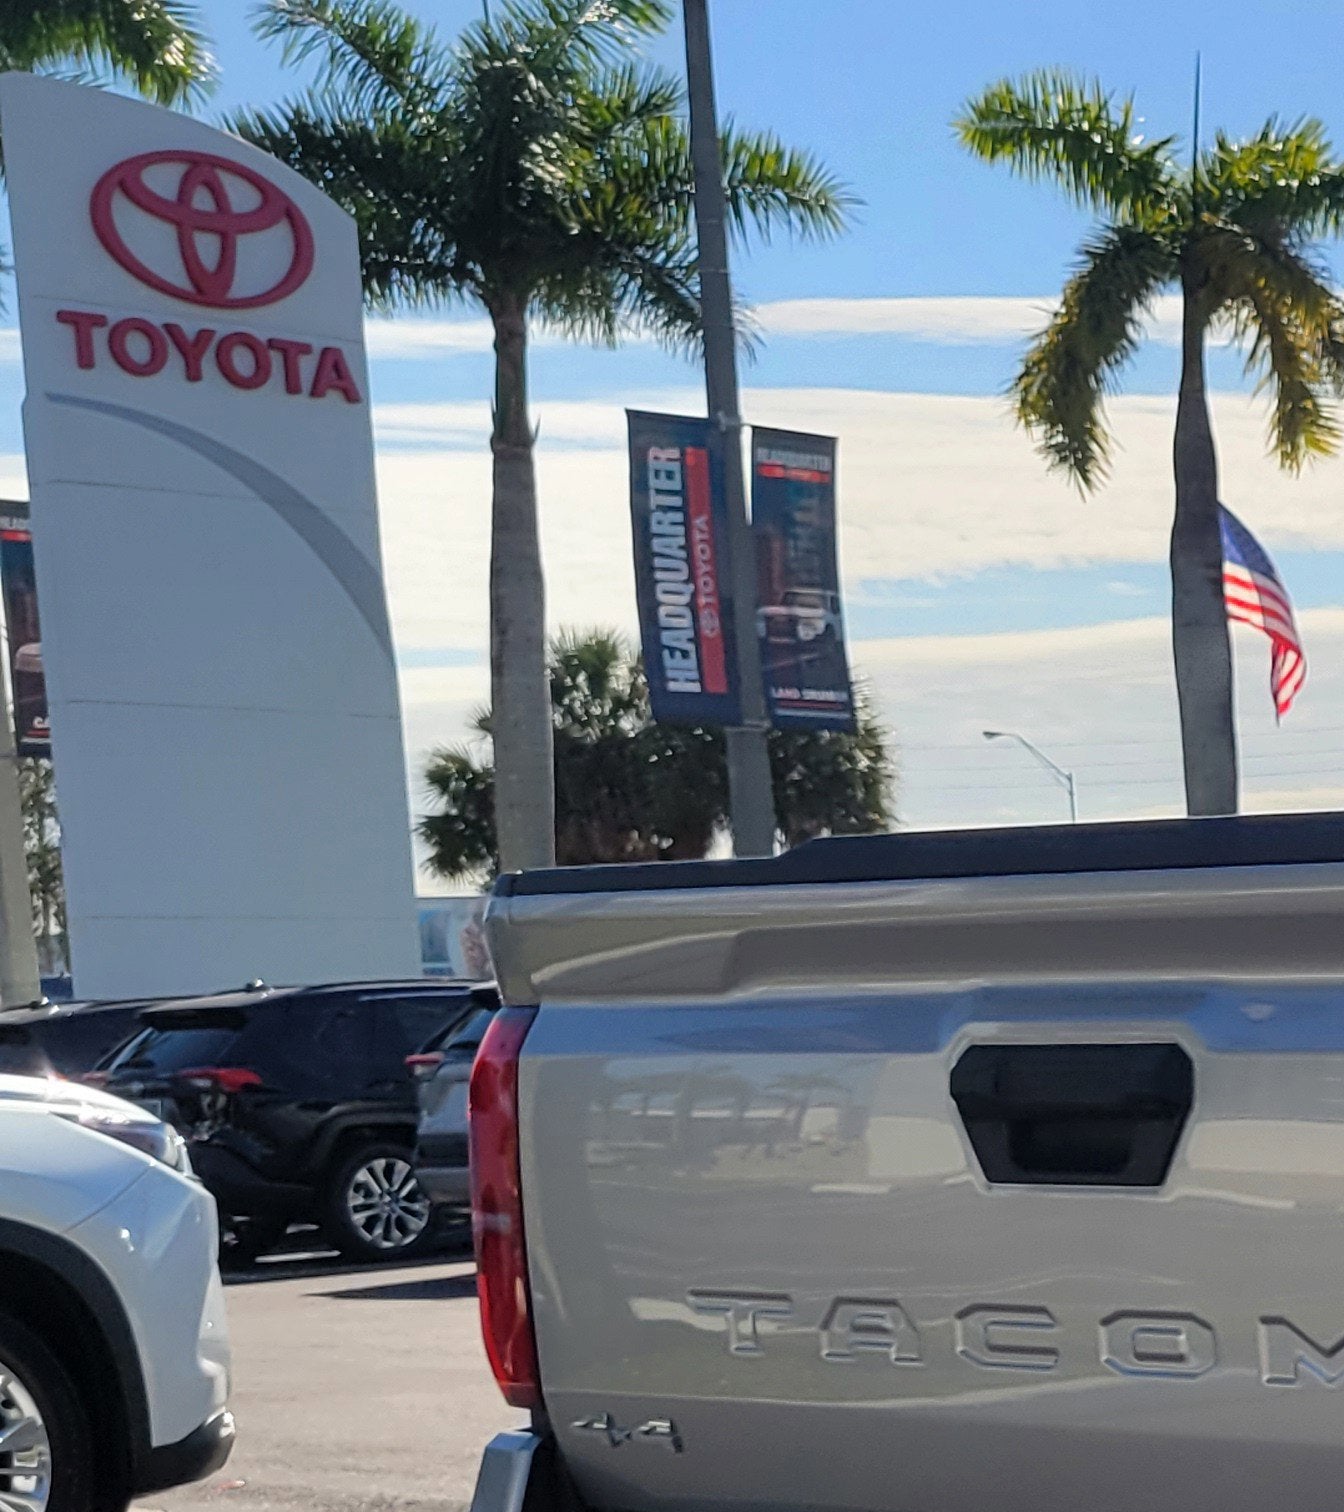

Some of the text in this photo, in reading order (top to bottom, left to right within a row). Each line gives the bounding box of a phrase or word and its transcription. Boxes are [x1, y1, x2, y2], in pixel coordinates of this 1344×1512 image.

[56, 309, 363, 404] TOYOTA
[648, 446, 702, 693] HEADQUARTER
[693, 515, 716, 605] TOYOTA
